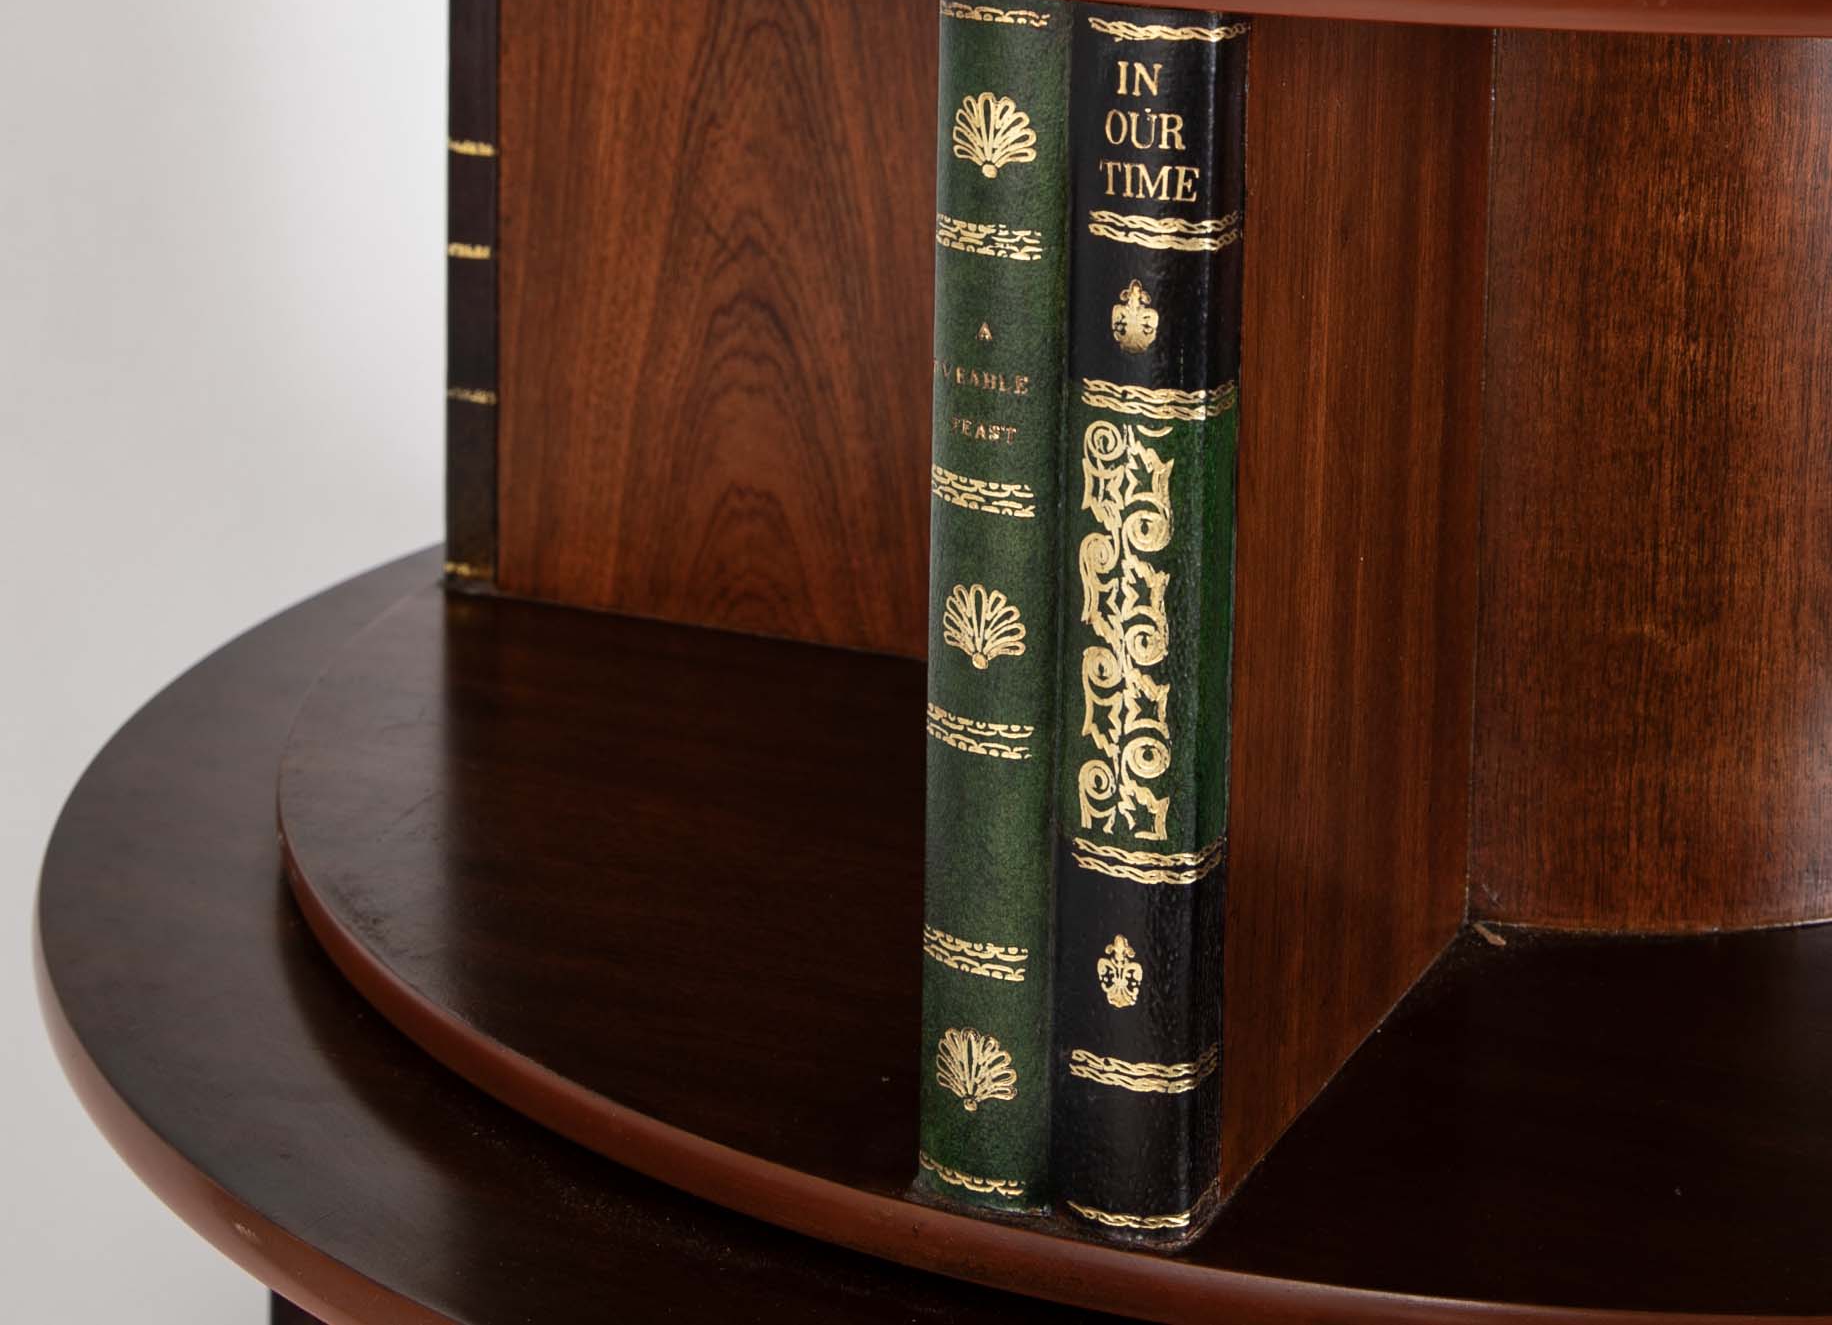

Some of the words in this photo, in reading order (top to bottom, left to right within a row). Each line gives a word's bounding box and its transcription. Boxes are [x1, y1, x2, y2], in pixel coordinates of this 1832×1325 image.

[1117, 61, 1163, 96] IN
[1105, 107, 1186, 150] OUR
[1099, 159, 1199, 202] TIME
[976, 322, 992, 341] A
[951, 417, 1017, 445] FEAST
